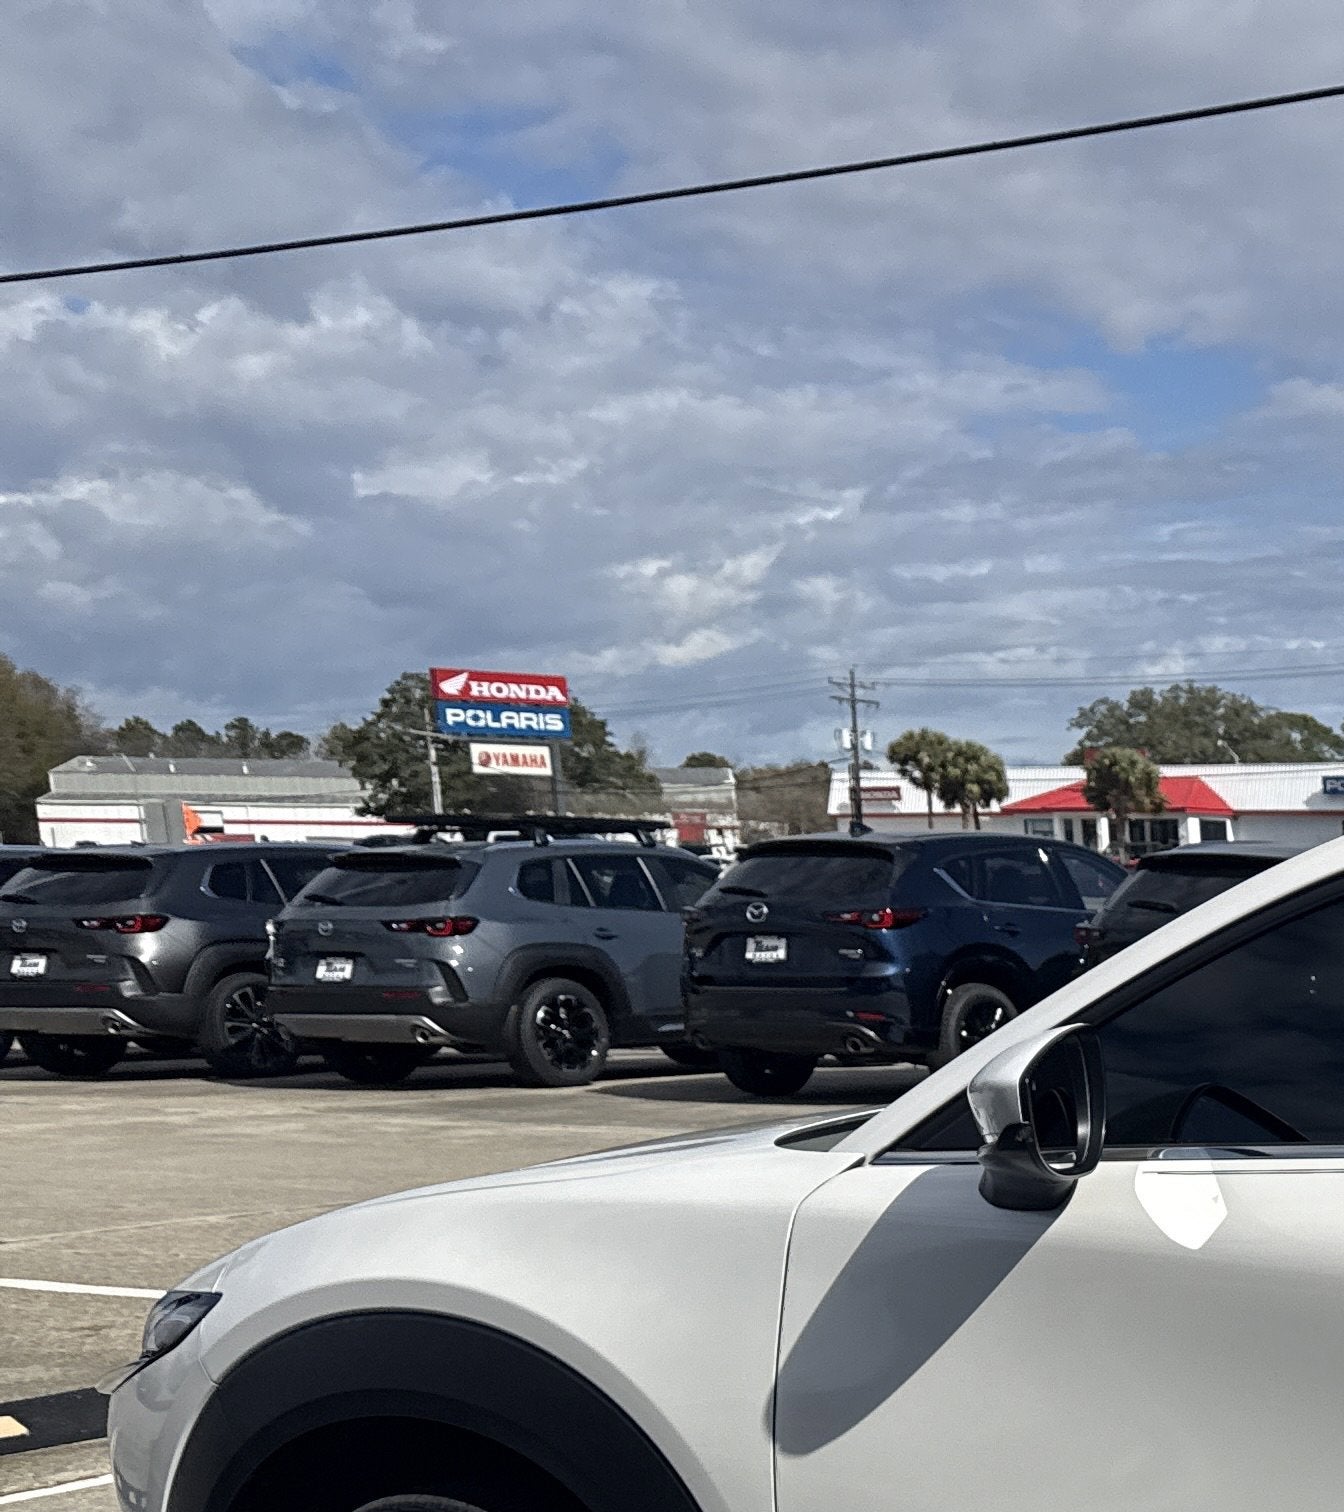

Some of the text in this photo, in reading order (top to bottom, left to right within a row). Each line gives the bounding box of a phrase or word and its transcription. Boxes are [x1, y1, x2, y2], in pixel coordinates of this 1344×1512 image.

[468, 680, 567, 701] HONDA
[445, 707, 565, 731] POLARIS
[492, 751, 547, 769] YAMAHA
